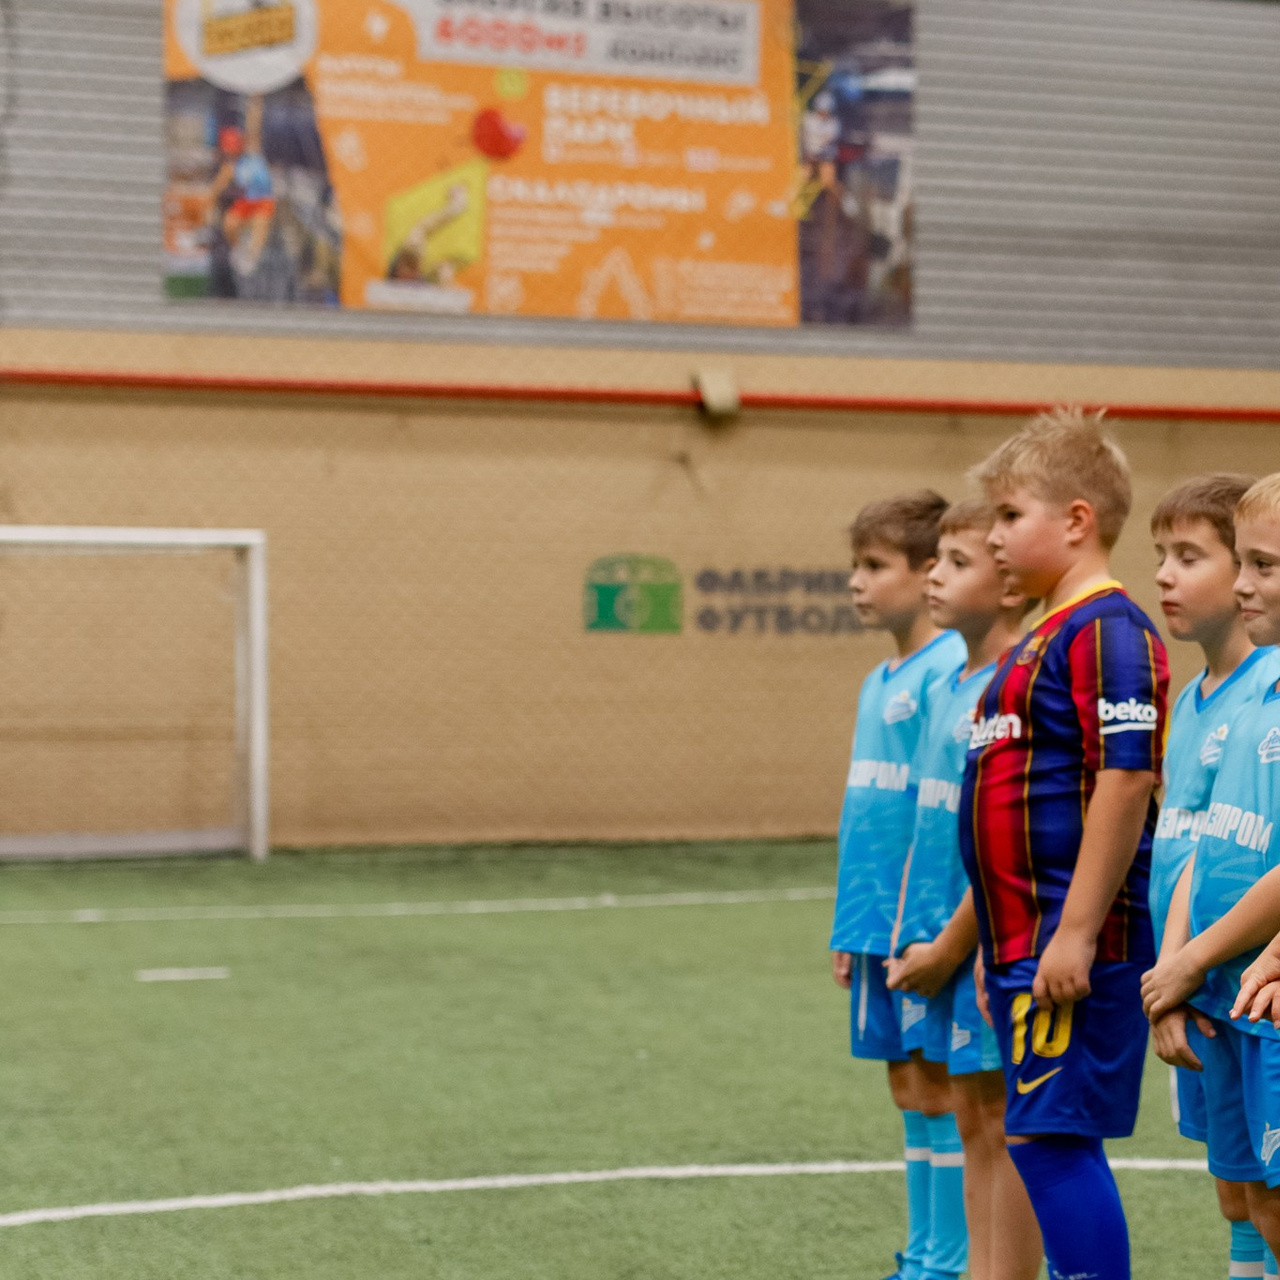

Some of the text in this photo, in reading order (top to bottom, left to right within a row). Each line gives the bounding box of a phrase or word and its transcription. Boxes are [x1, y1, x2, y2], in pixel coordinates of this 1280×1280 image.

[695, 568, 852, 594] ФАБРИК
[696, 605, 864, 634] ФУТБОЛ
[1097, 697, 1158, 722] beko
[1204, 802, 1274, 854] ЗПРОМ
[1011, 993, 1074, 1065] 10
